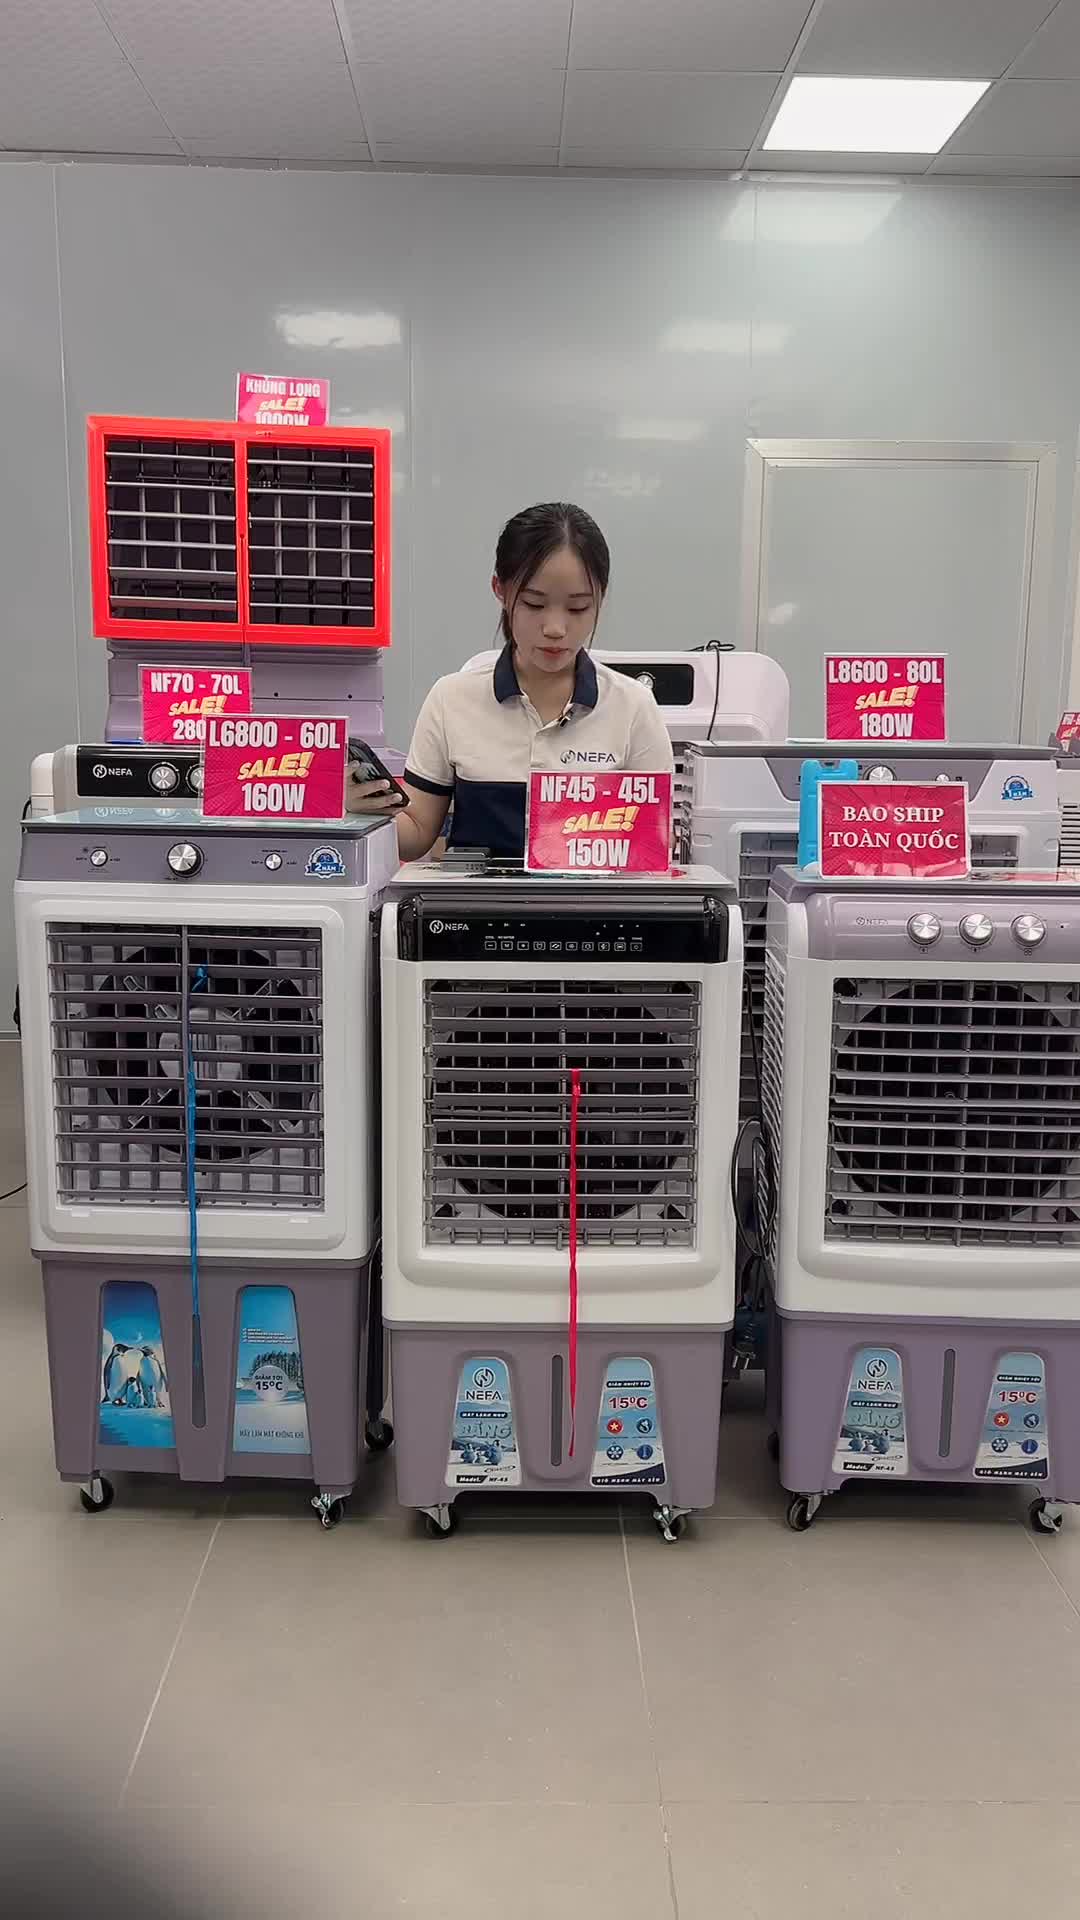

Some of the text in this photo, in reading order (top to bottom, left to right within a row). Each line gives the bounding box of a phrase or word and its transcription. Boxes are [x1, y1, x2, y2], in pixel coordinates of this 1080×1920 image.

[289, 381, 321, 398] LONG
[151, 672, 194, 694] NF70
[211, 673, 242, 695] 70L
[828, 660, 888, 684] L8600
[907, 660, 942, 684] 80L
[168, 695, 228, 717] SALE!
[854, 685, 919, 710] SALE!
[173, 719, 206, 741] 280
[209, 720, 278, 749] L6800
[300, 721, 341, 749] 60L
[859, 713, 914, 738] 180W
[237, 751, 316, 781] SALE!
[577, 751, 617, 763] NEFA
[108, 768, 133, 777] NEFA
[241, 783, 306, 813] 160W
[540, 775, 596, 803] NF45
[618, 776, 660, 804] 45L
[562, 805, 640, 834] SALE!
[842, 806, 944, 823] BAO SHIP
[829, 828, 960, 853] TOÀN QUỐC
[566, 838, 630, 868] 150W
[444, 923, 470, 931] NEFA
[465, 1390, 502, 1401] NEFA
[858, 1379, 894, 1391] NEFA
